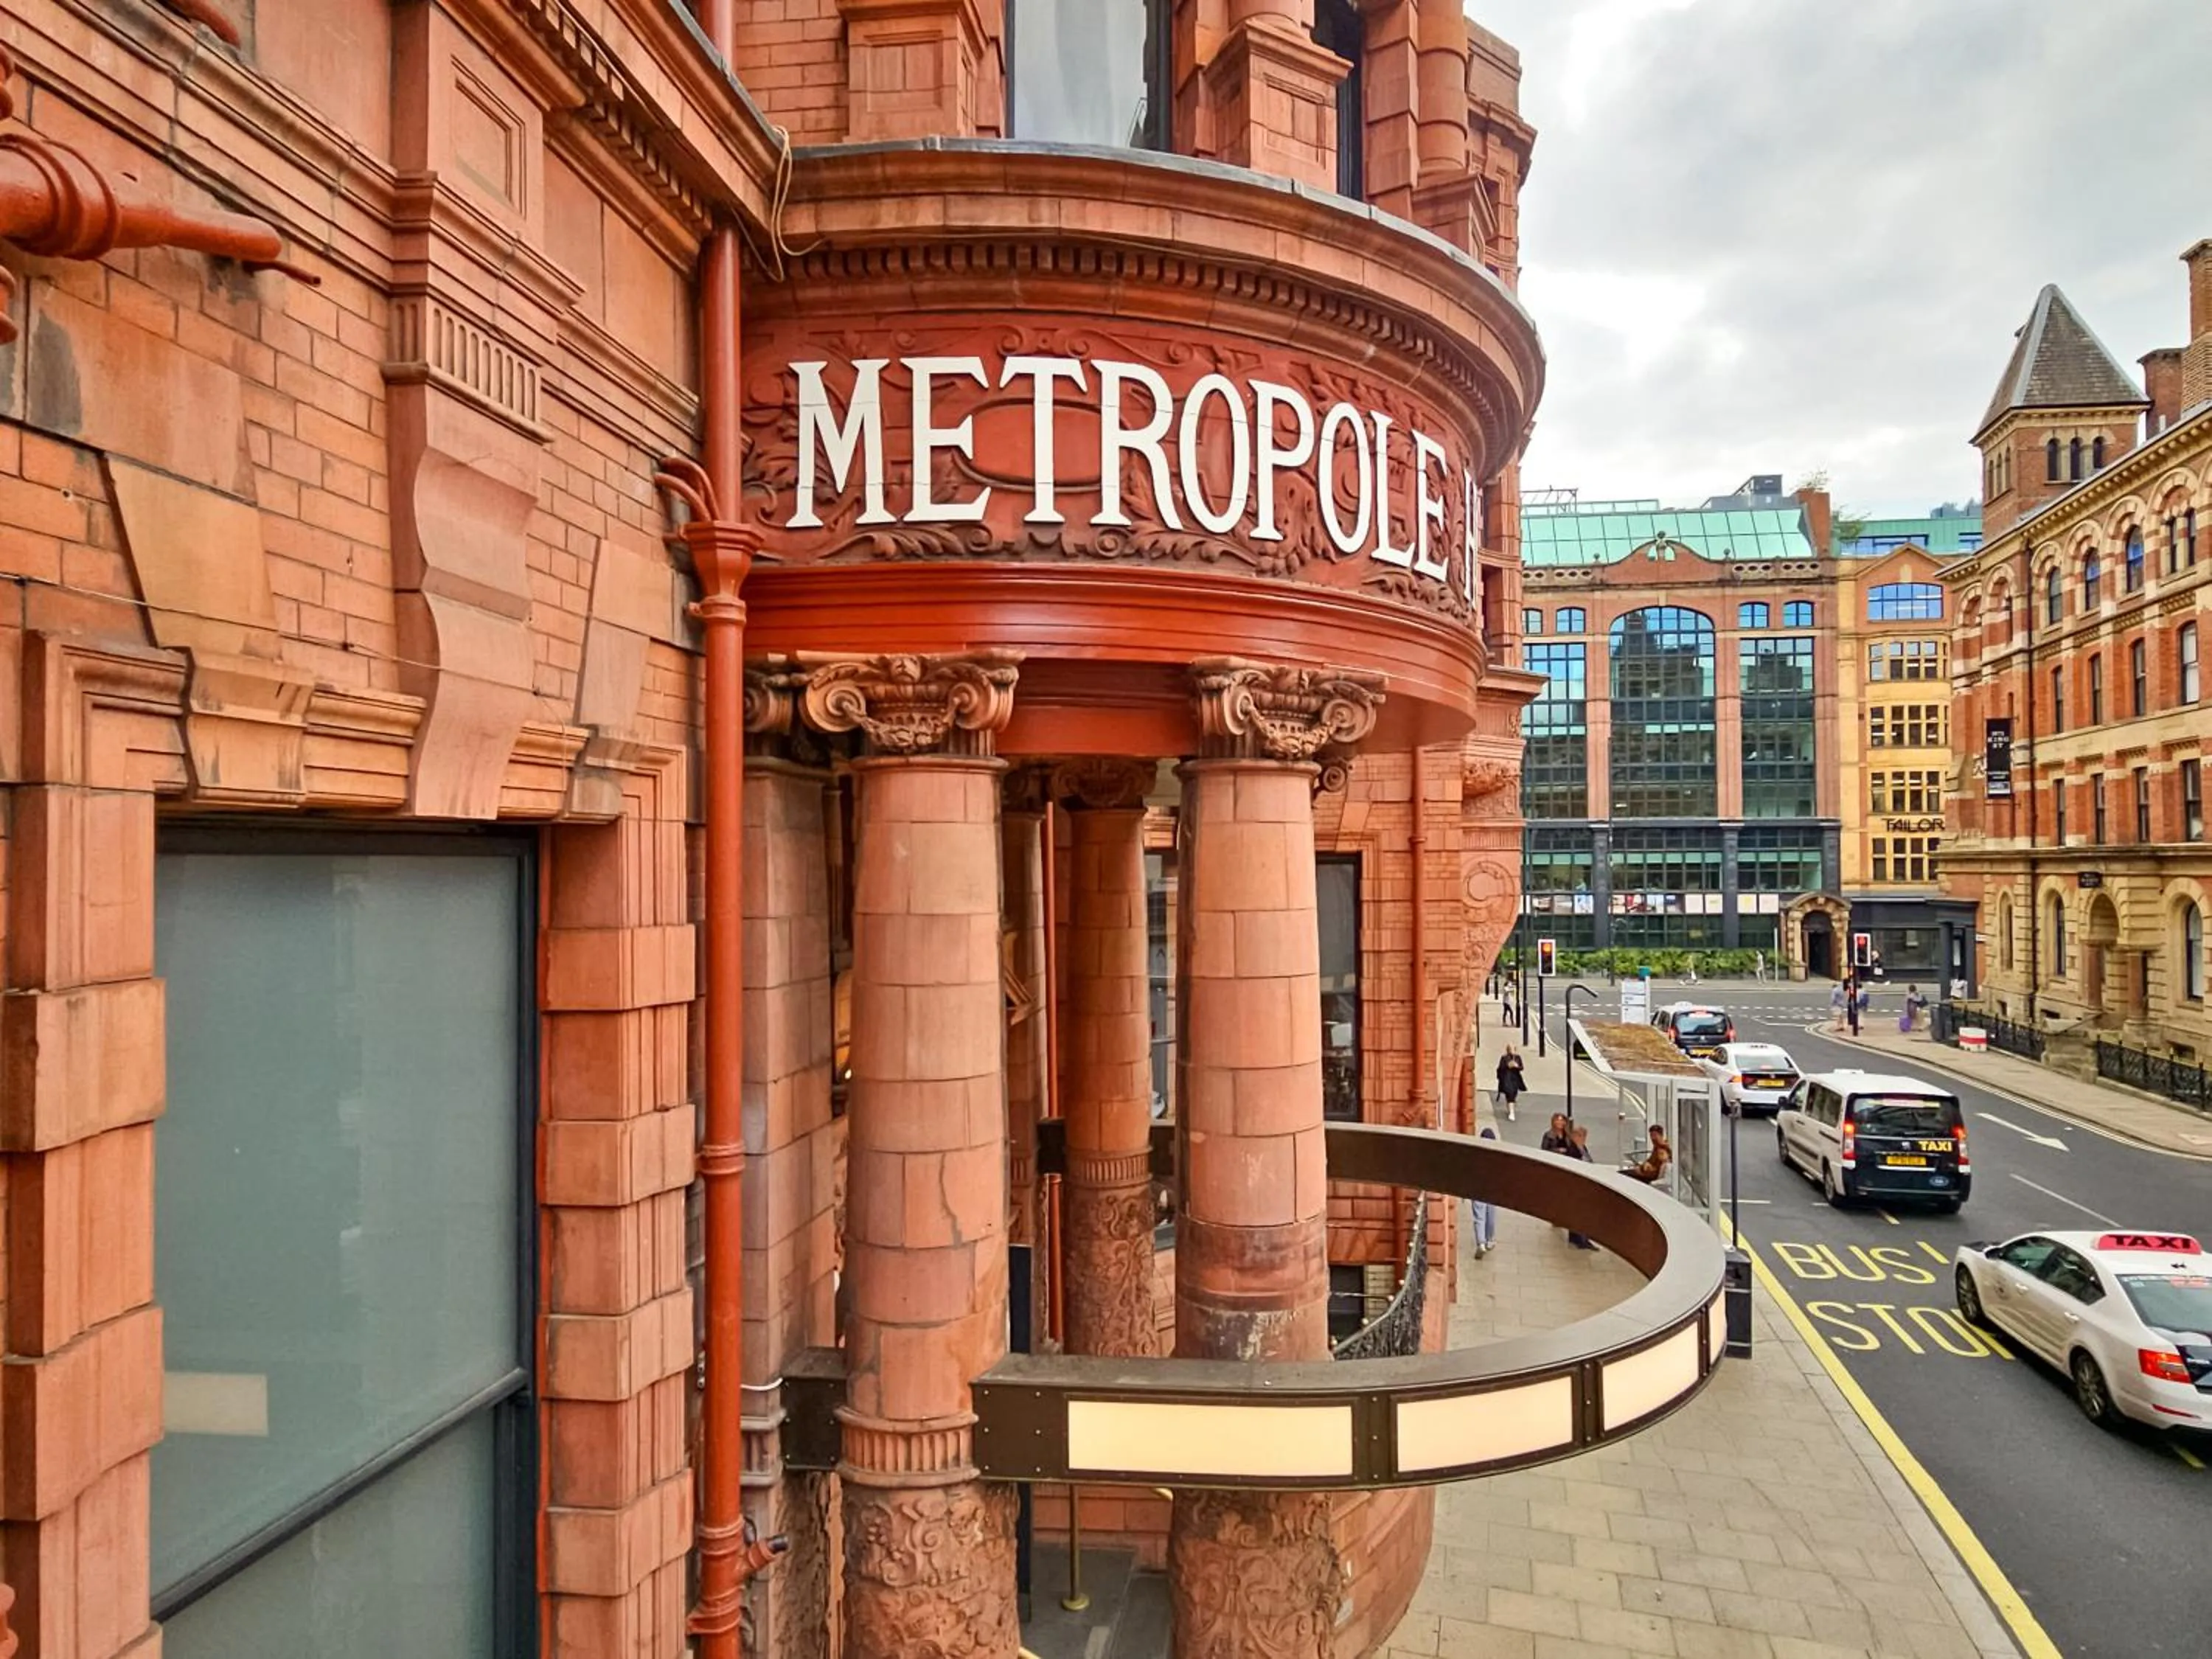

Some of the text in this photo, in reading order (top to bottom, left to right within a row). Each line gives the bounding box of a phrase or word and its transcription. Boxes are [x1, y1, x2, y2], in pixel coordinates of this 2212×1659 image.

[785, 355, 1450, 582] METROPOLE
[1918, 1141, 1952, 1152] TAXI
[2109, 1234, 2191, 1249] TAXI
[1771, 1242, 1936, 1284] BUS
